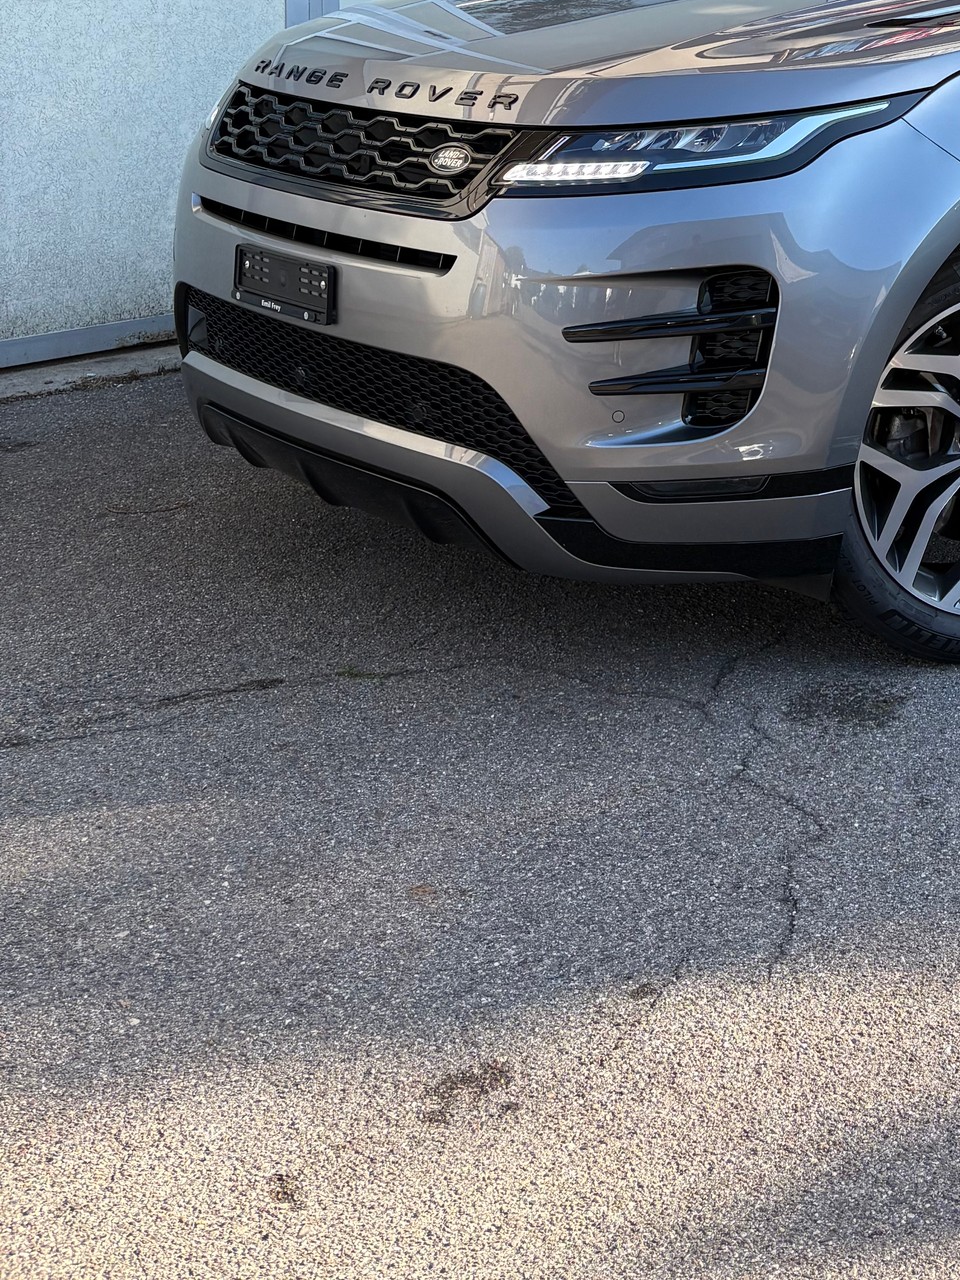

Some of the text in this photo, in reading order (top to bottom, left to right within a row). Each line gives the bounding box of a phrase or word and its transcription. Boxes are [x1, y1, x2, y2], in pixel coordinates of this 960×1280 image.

[254, 59, 520, 110] RANGE ROVER
[438, 150, 461, 159] LAND
[437, 157, 463, 168] ROVER
[261, 299, 281, 313] Emil Frey
[851, 579, 879, 606] PILOT
